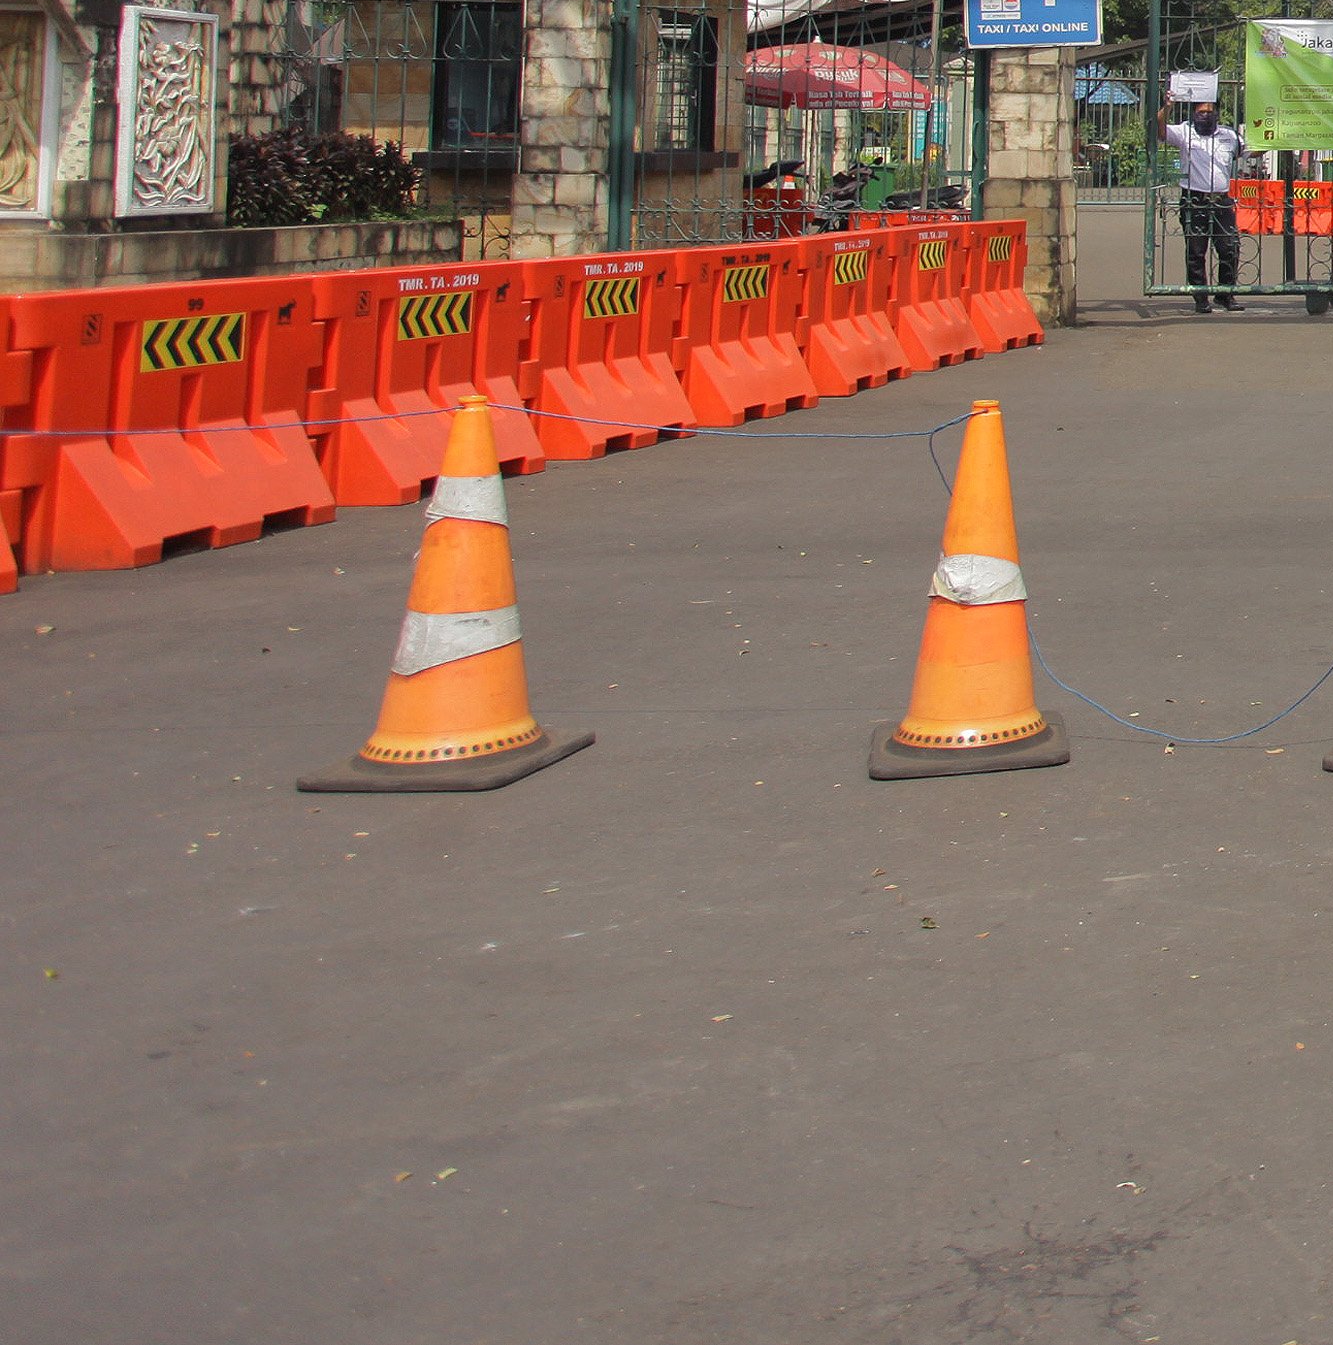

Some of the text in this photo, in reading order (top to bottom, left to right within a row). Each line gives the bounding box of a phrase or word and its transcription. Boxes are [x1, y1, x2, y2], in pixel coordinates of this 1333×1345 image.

[977, 24, 1004, 34] TAXI
[1012, 24, 1039, 33] TAXI
[1041, 22, 1089, 32] ONLINE
[624, 261, 644, 272] 2019
[453, 273, 480, 287] 2019
